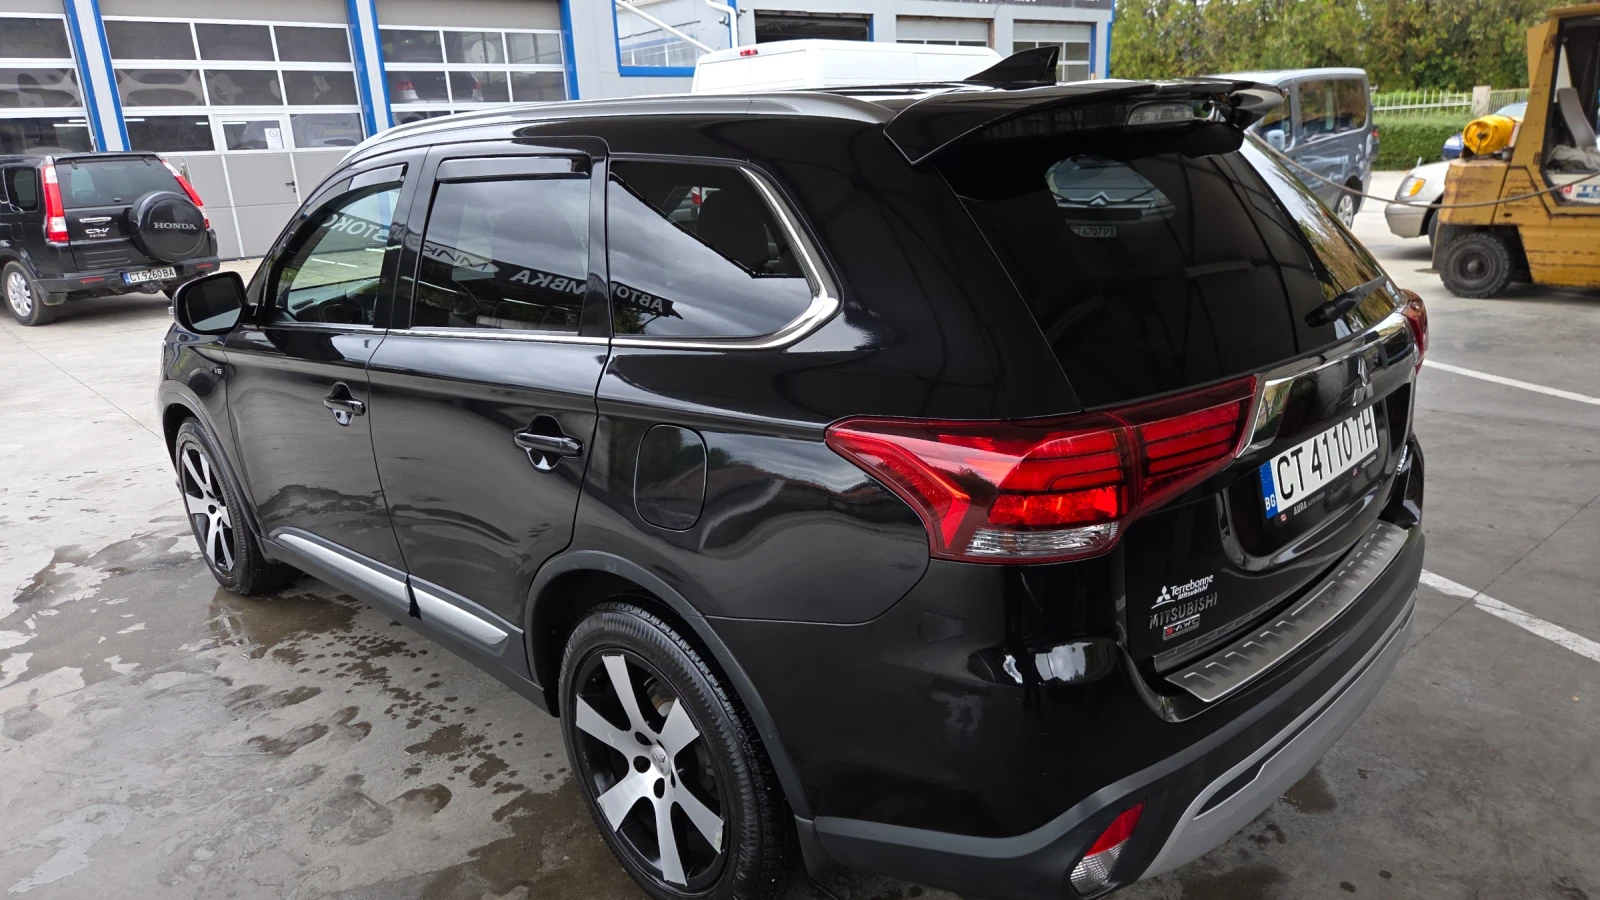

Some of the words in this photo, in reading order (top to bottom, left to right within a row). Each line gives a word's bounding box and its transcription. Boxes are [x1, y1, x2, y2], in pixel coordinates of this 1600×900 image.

[153, 222, 197, 230] HONDA
[129, 272, 140, 282] CT
[142, 269, 162, 281] 9260
[162, 268, 176, 278] BA
[1277, 446, 1305, 501] CT
[1311, 421, 1353, 481] 4110
[1352, 405, 1375, 453] TH
[1264, 494, 1277, 511] BG
[1293, 501, 1308, 516] AURA
[1170, 574, 1214, 597] Terrebonne
[1149, 592, 1218, 630] MITSUBISHI
[1165, 617, 1199, 637] S-AWC
